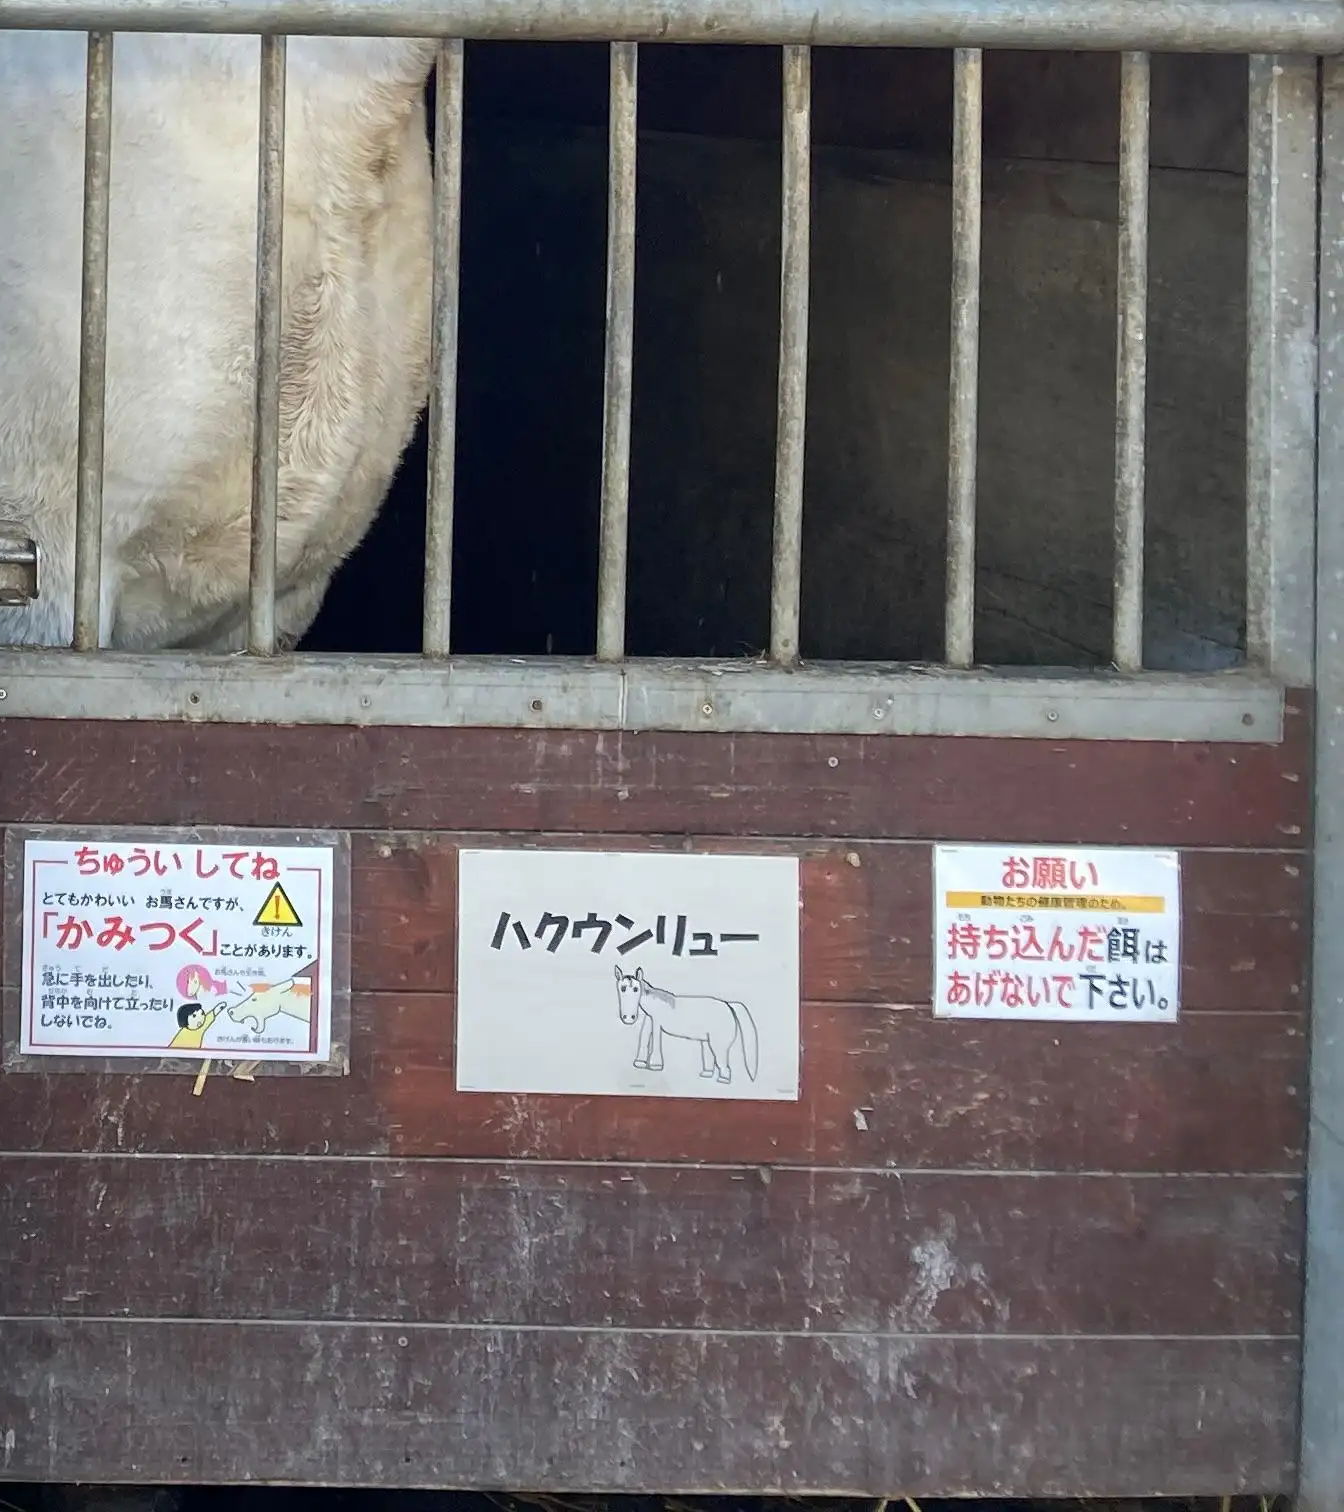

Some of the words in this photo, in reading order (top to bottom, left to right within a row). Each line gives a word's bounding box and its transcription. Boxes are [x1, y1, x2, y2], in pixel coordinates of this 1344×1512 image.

[75, 846, 182, 877] ちゅうい
[196, 849, 280, 881] してね
[1002, 856, 1099, 889] お願い
[42, 891, 135, 907] とてもかわいい
[145, 893, 244, 912] お馬さんですが、
[491, 912, 760, 956] ハクウンリュー
[947, 922, 1169, 964] 持ち込んだ餌は
[220, 944, 313, 960] ことがあります。
[42, 971, 153, 989] 急に手を出したり、
[946, 968, 1170, 1011] あげないで下さい。
[41, 994, 173, 1012] 背中を向けて立ったり
[40, 1014, 112, 1029] しないでね。
